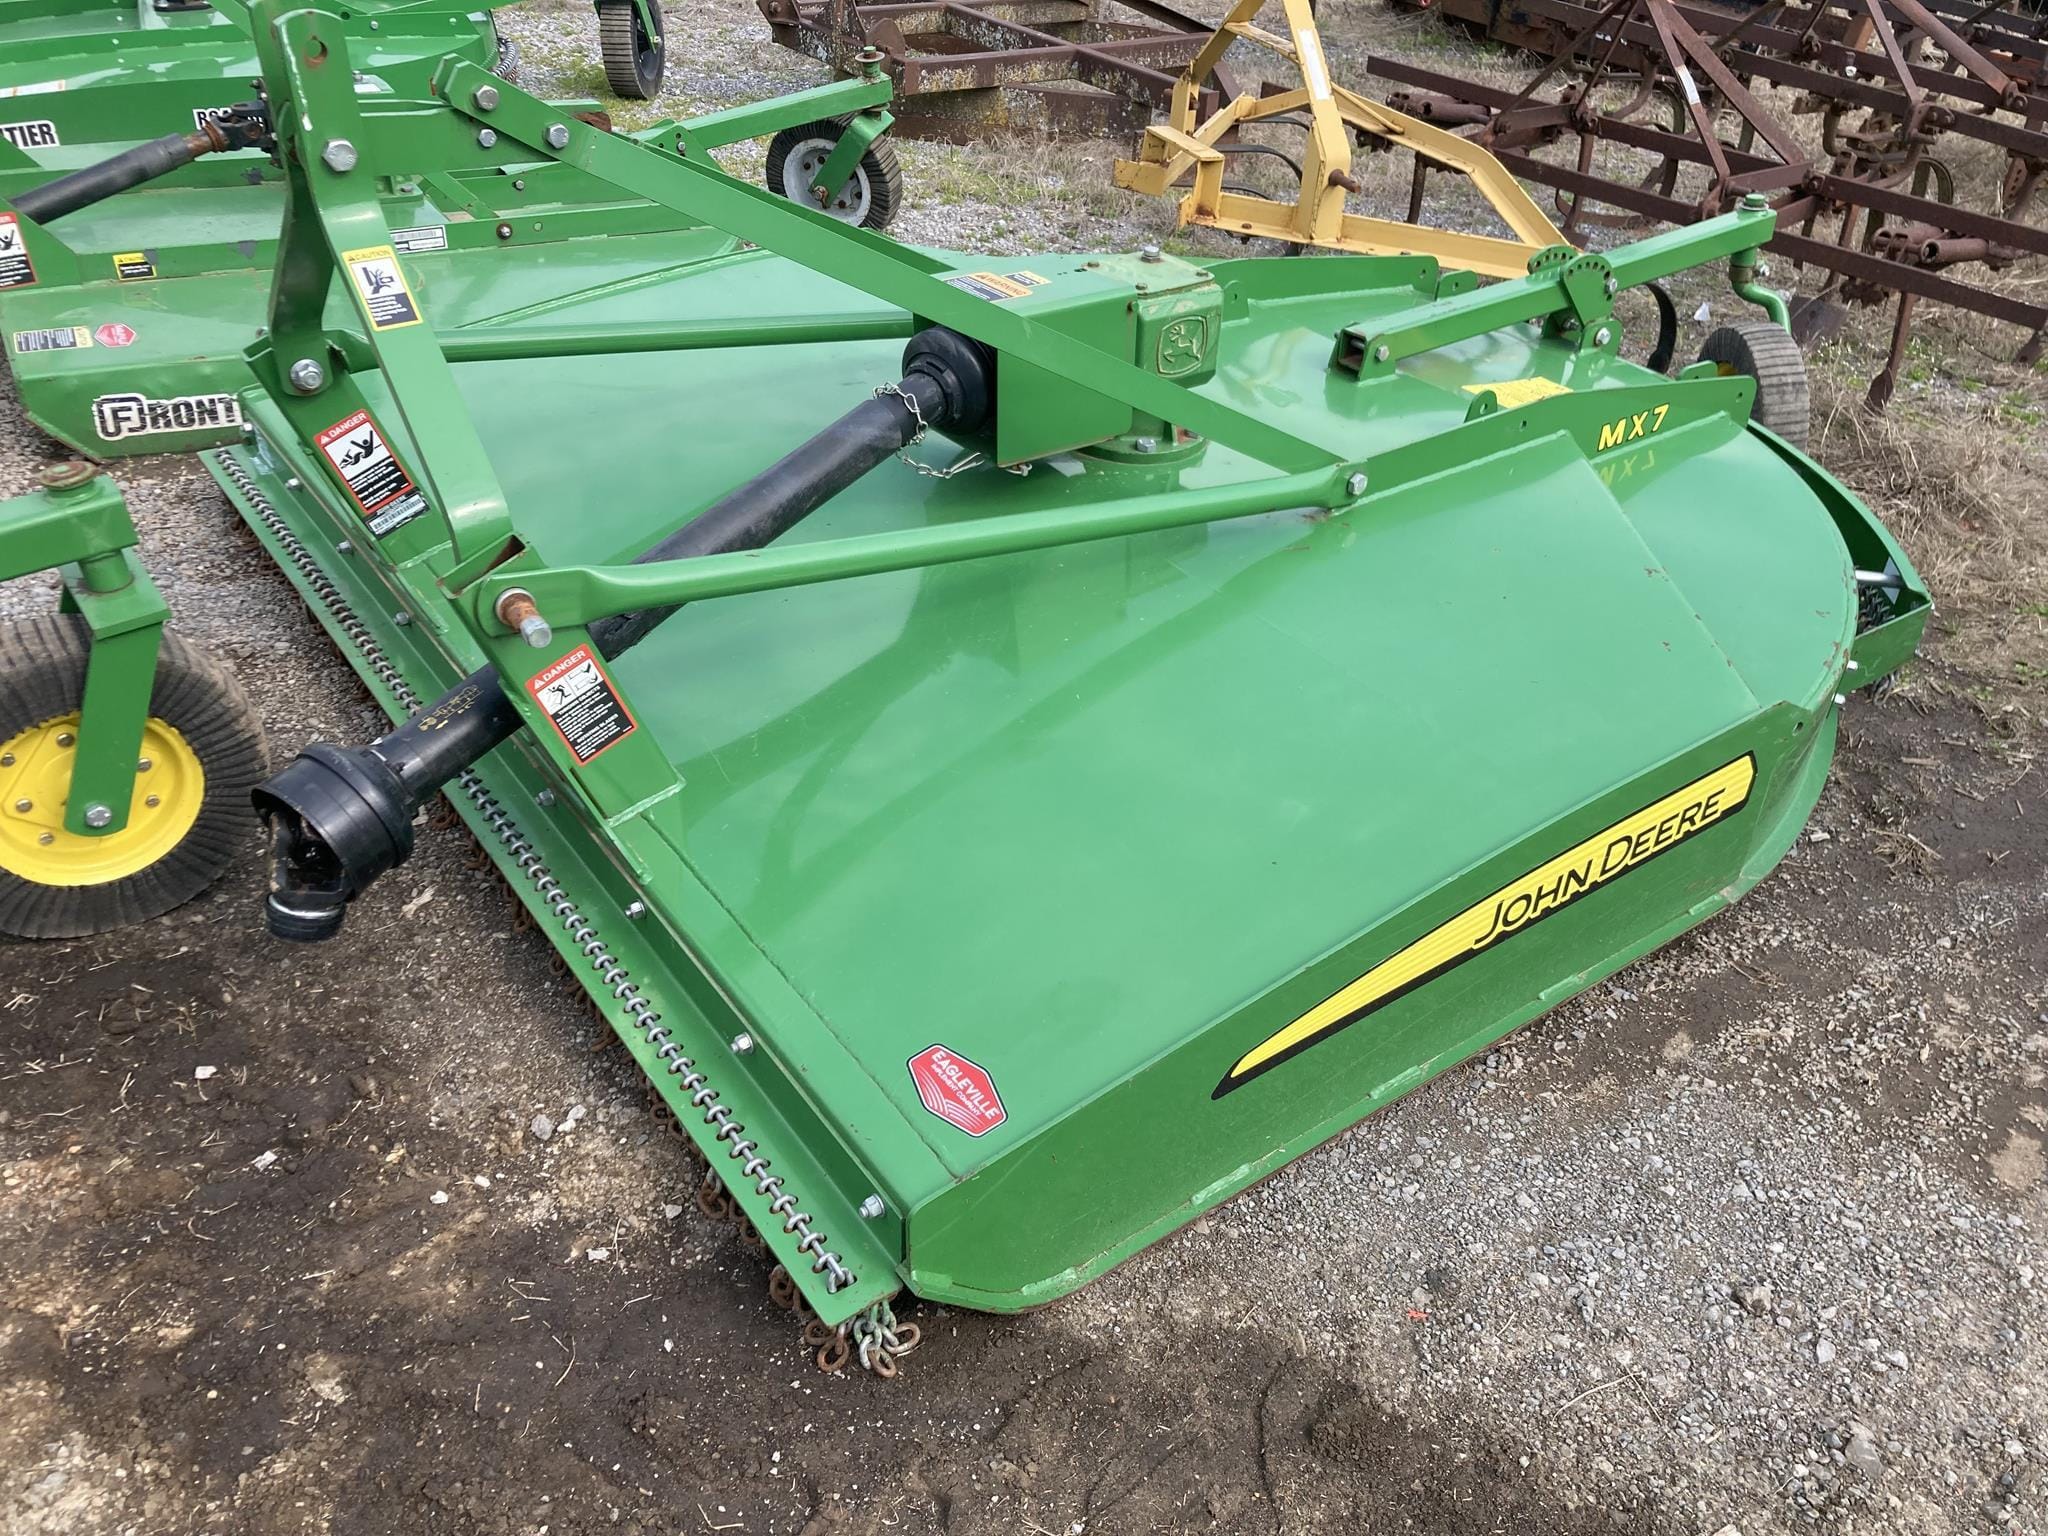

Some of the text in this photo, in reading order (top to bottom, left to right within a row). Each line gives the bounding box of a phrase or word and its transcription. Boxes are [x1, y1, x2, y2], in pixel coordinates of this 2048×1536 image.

[328, 412, 367, 438] DANGER
[1598, 403, 1670, 452] MX7
[542, 650, 586, 682] DANGER
[1474, 788, 1725, 945] JOHN DEERE
[931, 1050, 1000, 1120] EAGLEVILLE
[931, 1063, 981, 1116] IMPLEMENT COMPANY
